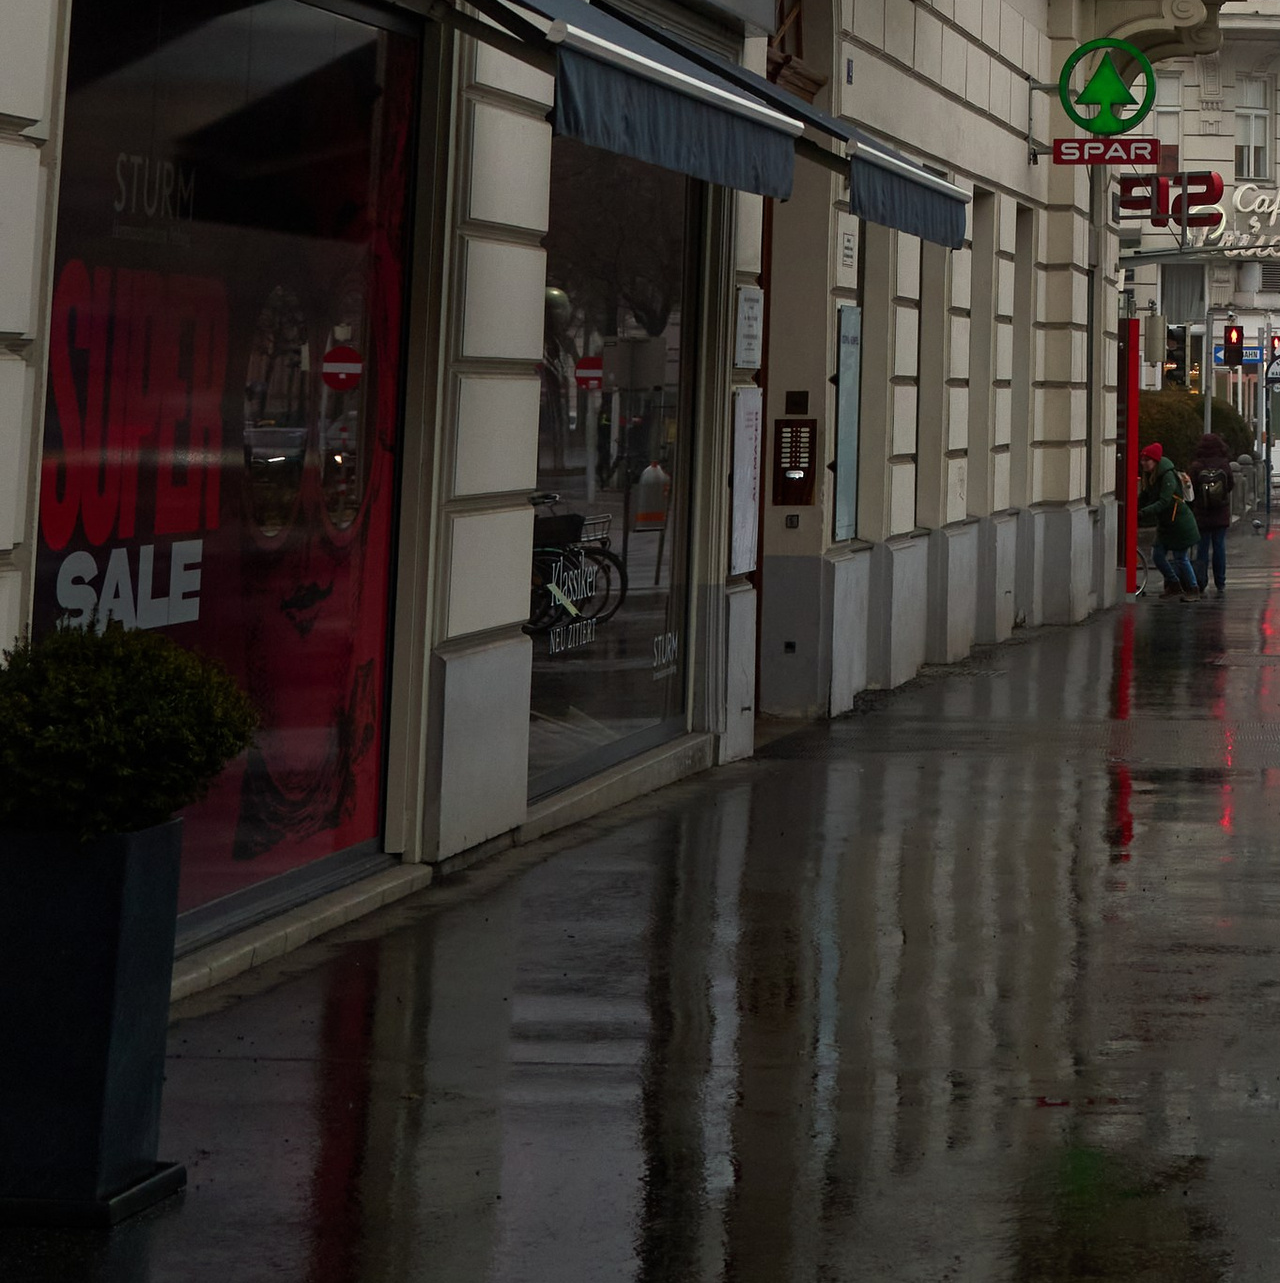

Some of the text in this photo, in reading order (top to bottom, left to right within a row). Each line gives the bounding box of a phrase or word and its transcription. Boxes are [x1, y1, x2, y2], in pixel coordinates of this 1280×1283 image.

[1060, 142, 1153, 160] SPAR
[113, 152, 196, 222] STURM
[42, 259, 230, 551] SUPER
[56, 540, 203, 632] SALE
[551, 549, 598, 606] Klassiker
[549, 619, 597, 654] NEU ZITIERT
[653, 631, 679, 667] STURM
